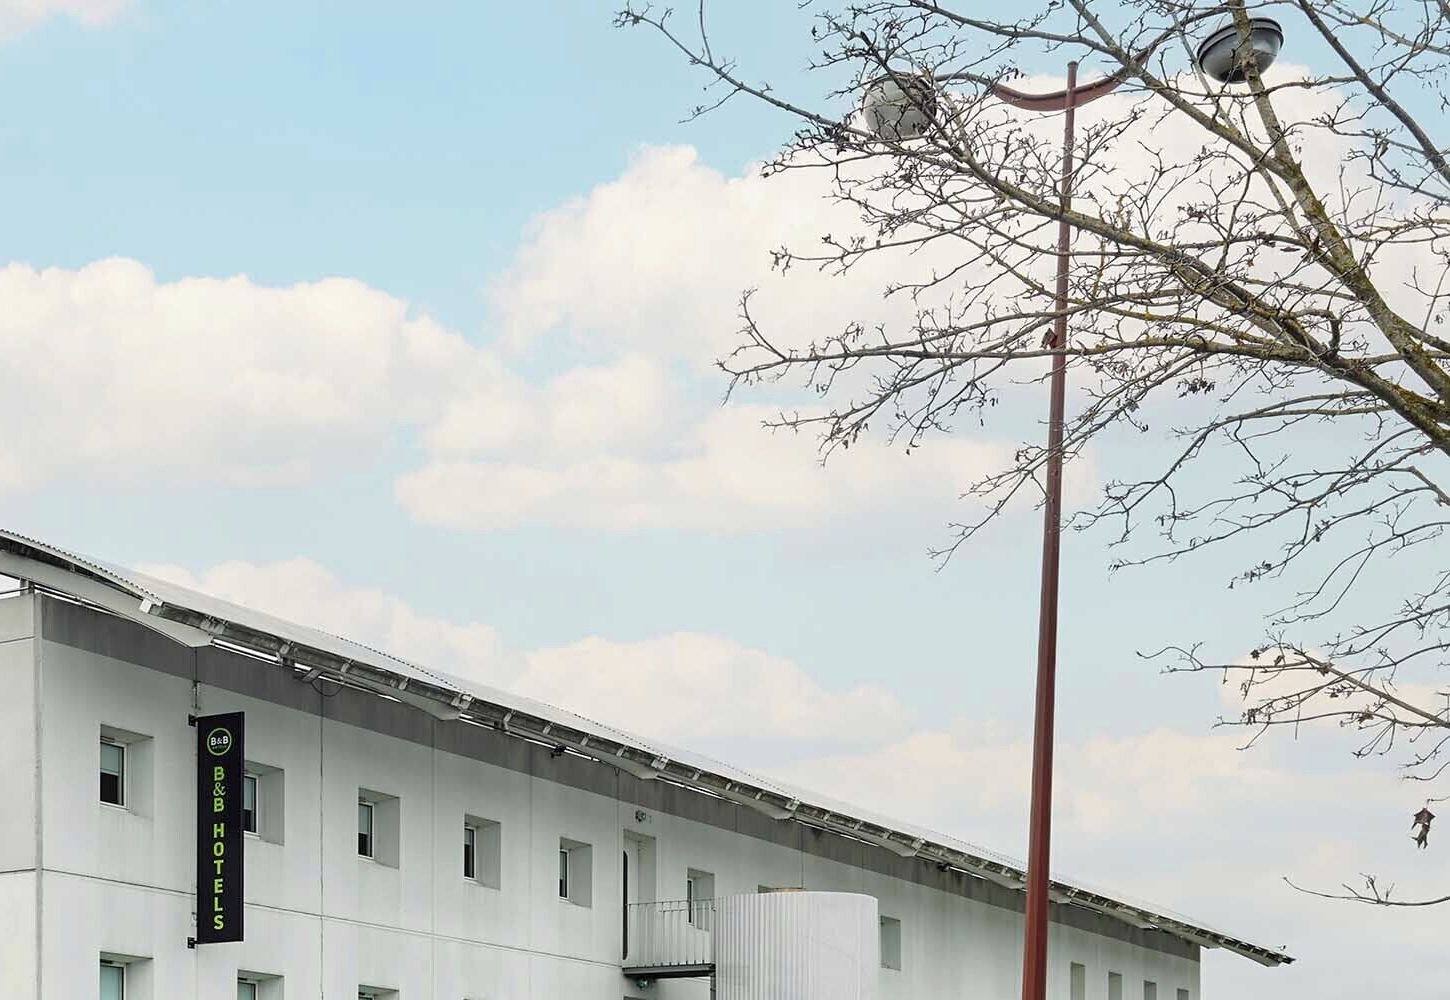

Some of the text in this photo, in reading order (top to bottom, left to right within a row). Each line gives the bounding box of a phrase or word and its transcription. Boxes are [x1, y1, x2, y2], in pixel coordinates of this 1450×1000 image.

[211, 735, 229, 746] B&B
[213, 766, 226, 931] B&B HOTELS
